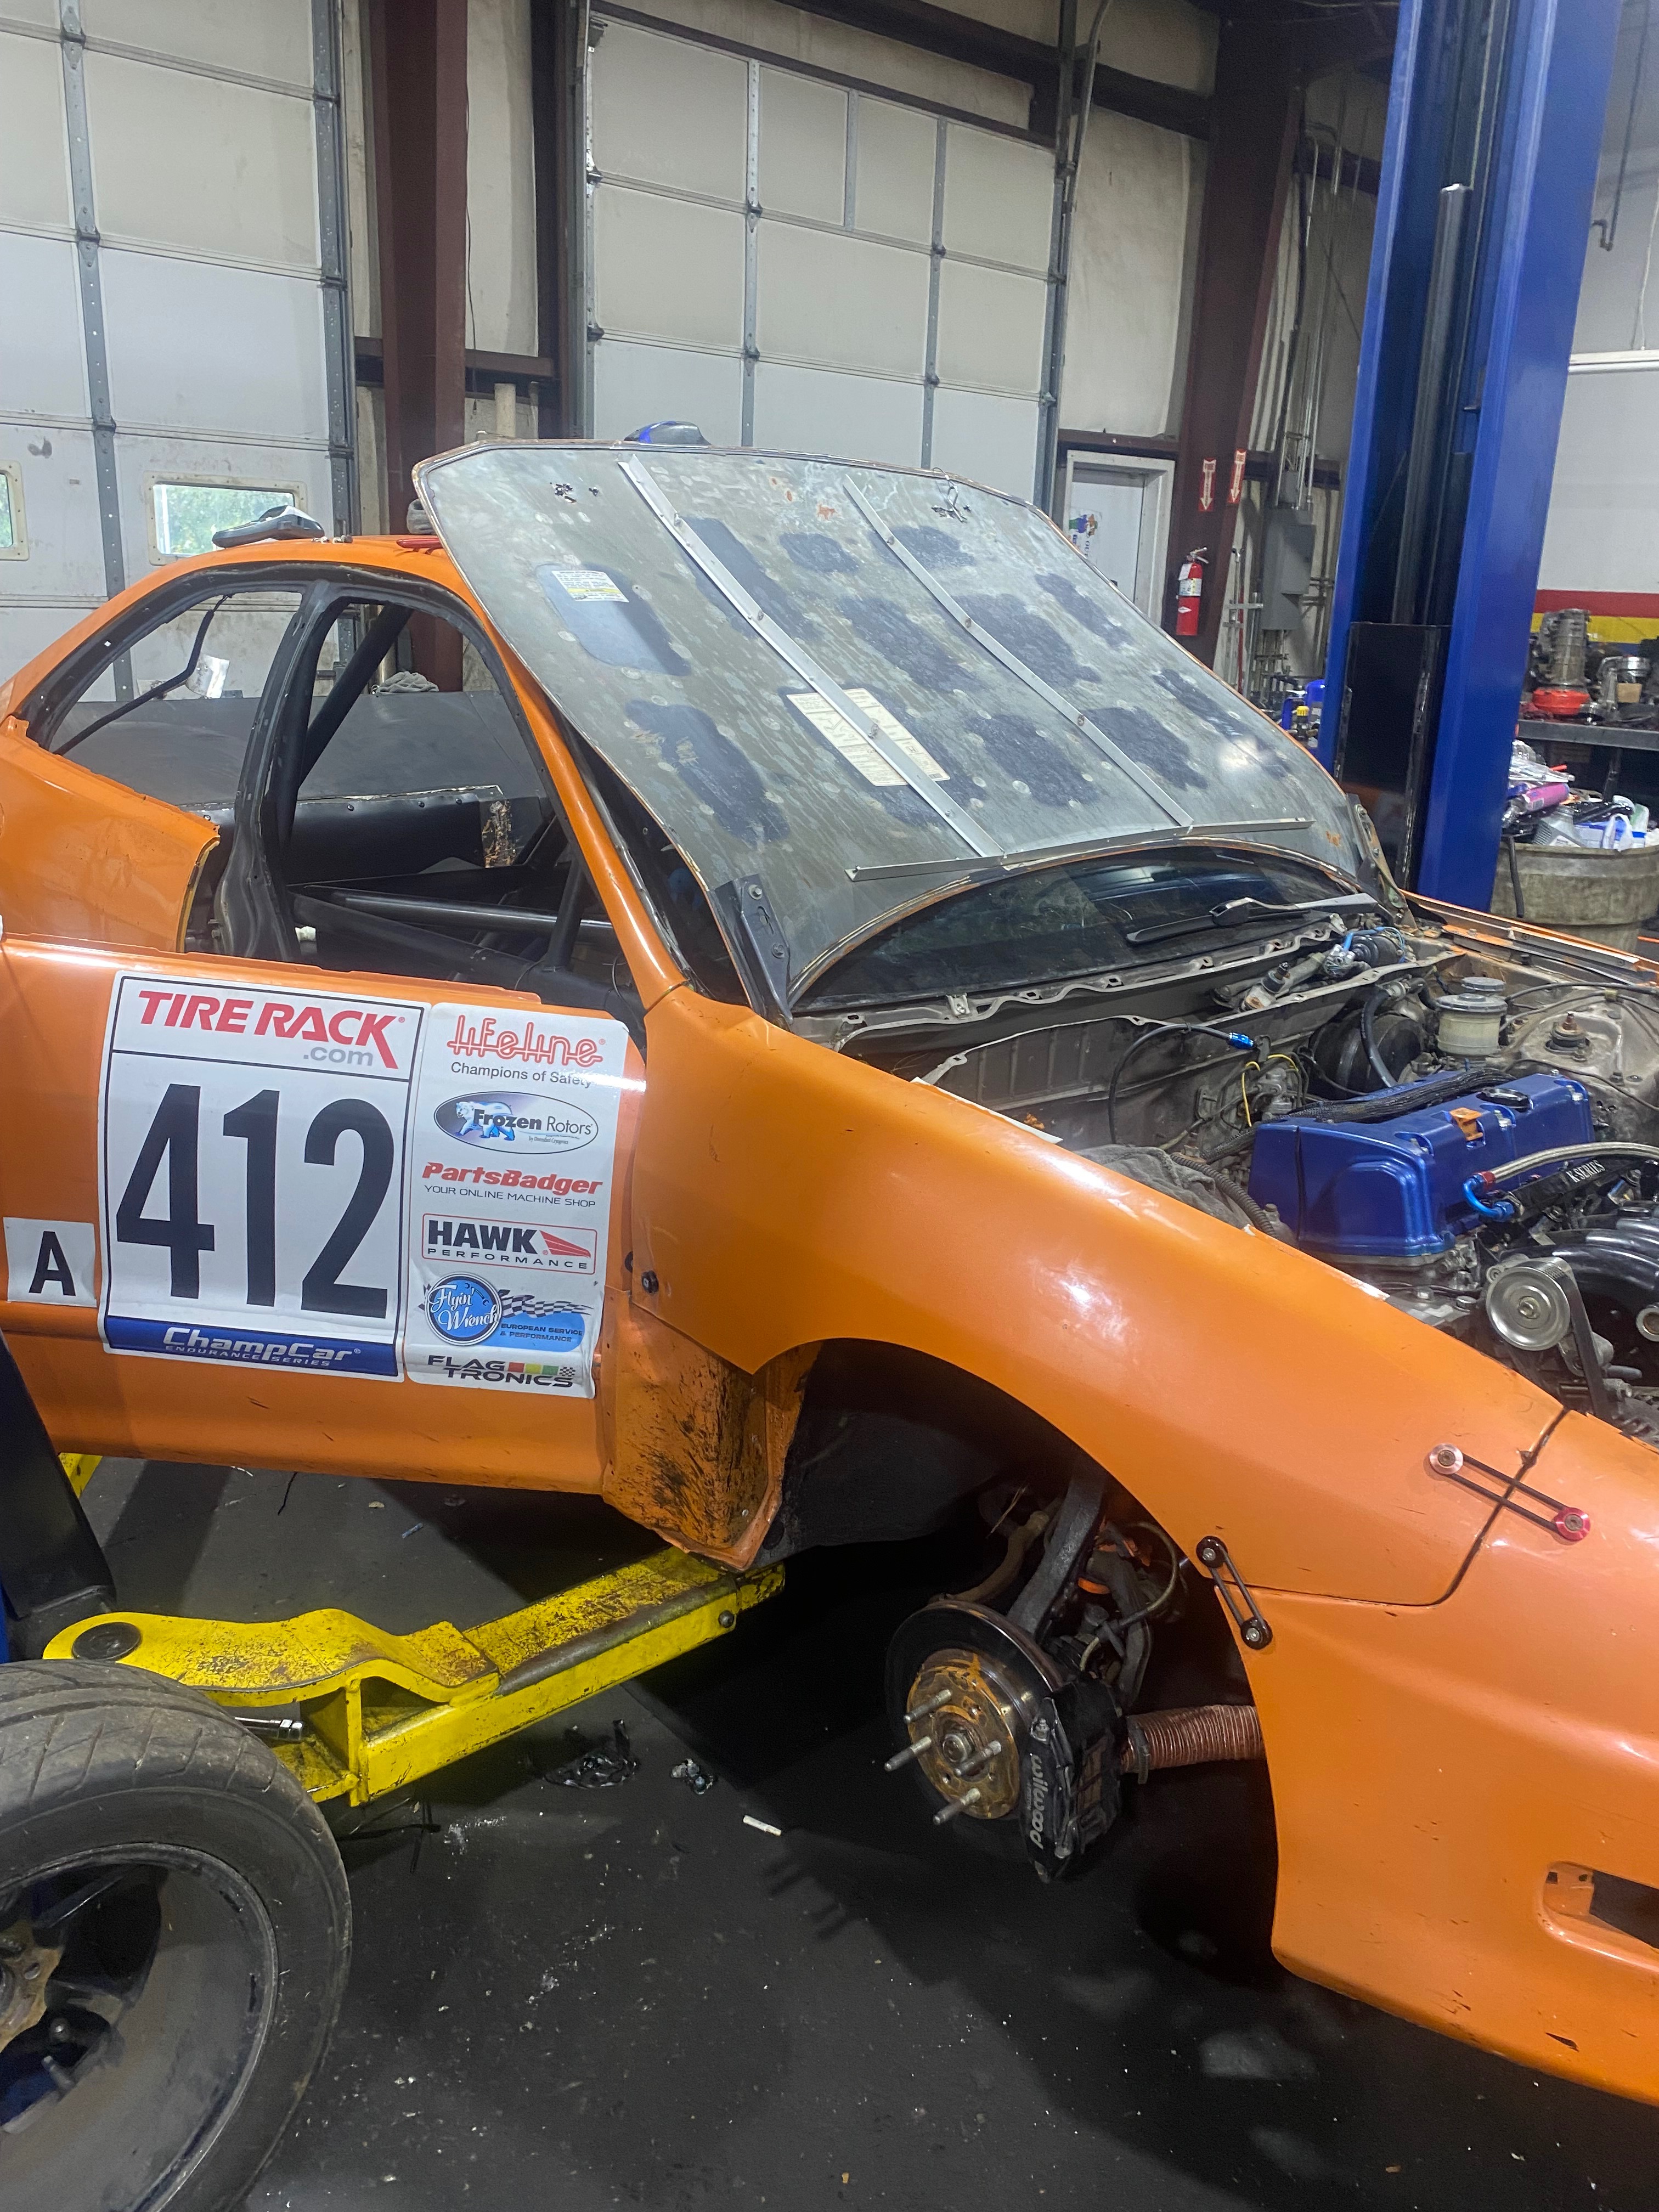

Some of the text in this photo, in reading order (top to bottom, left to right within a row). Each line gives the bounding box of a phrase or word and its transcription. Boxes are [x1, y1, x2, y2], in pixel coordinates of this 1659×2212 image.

[138, 990, 399, 1070] TIRE RACK
[303, 1047, 374, 1066] .com
[451, 1062, 528, 1080] Champions
[532, 1071, 546, 1082] of
[473, 1109, 591, 1135] Frozen Rotors
[422, 1162, 603, 1195] PartsBadger
[1566, 1160, 1605, 1183] K-SERIES
[116, 1084, 394, 1319] 412
[424, 1184, 596, 1207] YOUR ONLINE MACHINE SHOP
[428, 1220, 538, 1255] HAWK
[29, 1231, 76, 1296] A
[428, 1248, 587, 1269] PERFORMANCE
[438, 1304, 499, 1330] Wrench
[501, 1323, 583, 1336] EUROPEAN SERVICE
[509, 1331, 572, 1342] PERFORMANCE
[163, 1327, 353, 1361] ChampCar
[166, 1345, 330, 1366] ENDURANCE SERIES
[428, 1355, 506, 1371] FLAG
[443, 1368, 573, 1387] TRONICS
